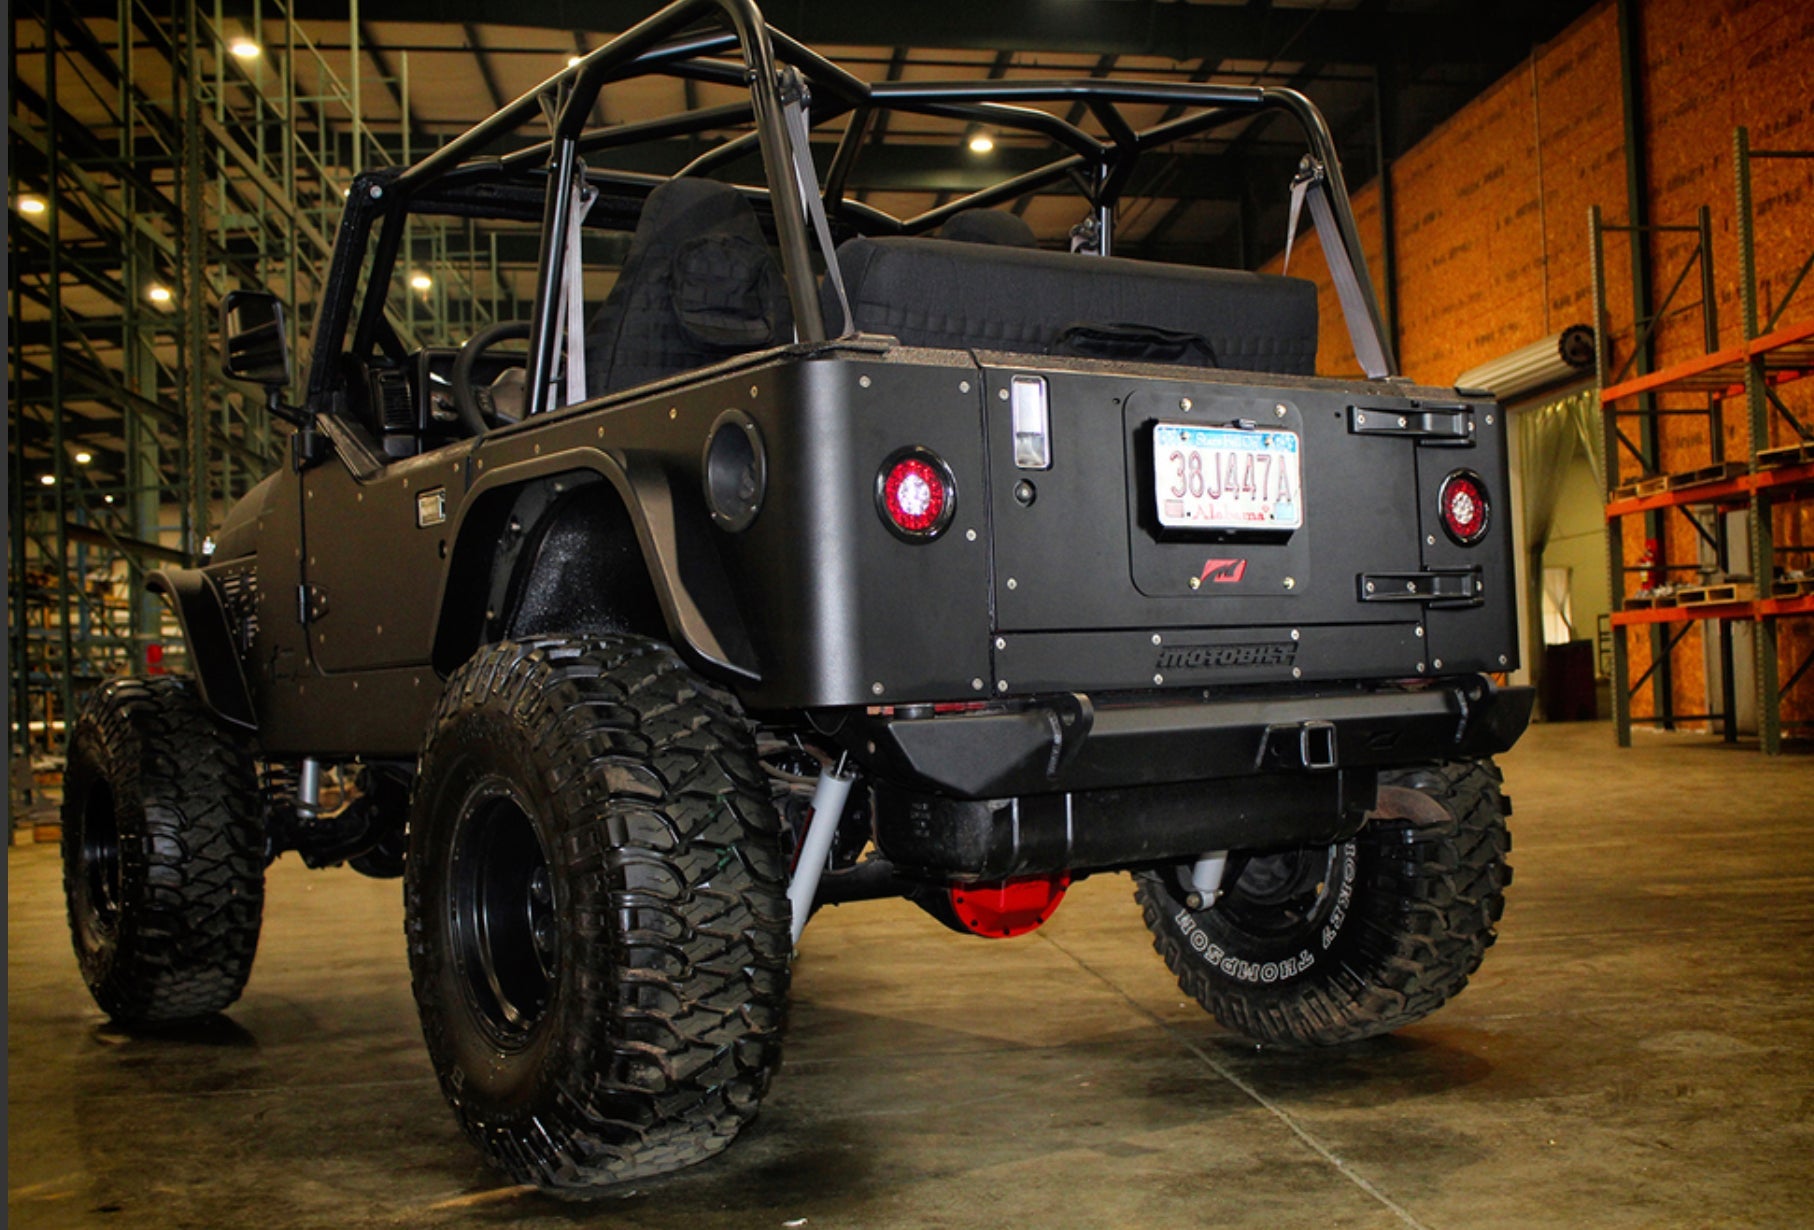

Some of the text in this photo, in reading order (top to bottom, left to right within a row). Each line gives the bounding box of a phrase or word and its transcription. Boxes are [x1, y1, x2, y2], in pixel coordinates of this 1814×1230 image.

[1169, 450, 1292, 502] 38J447A
[1175, 838, 1358, 983] ICKEY THOMPSON
